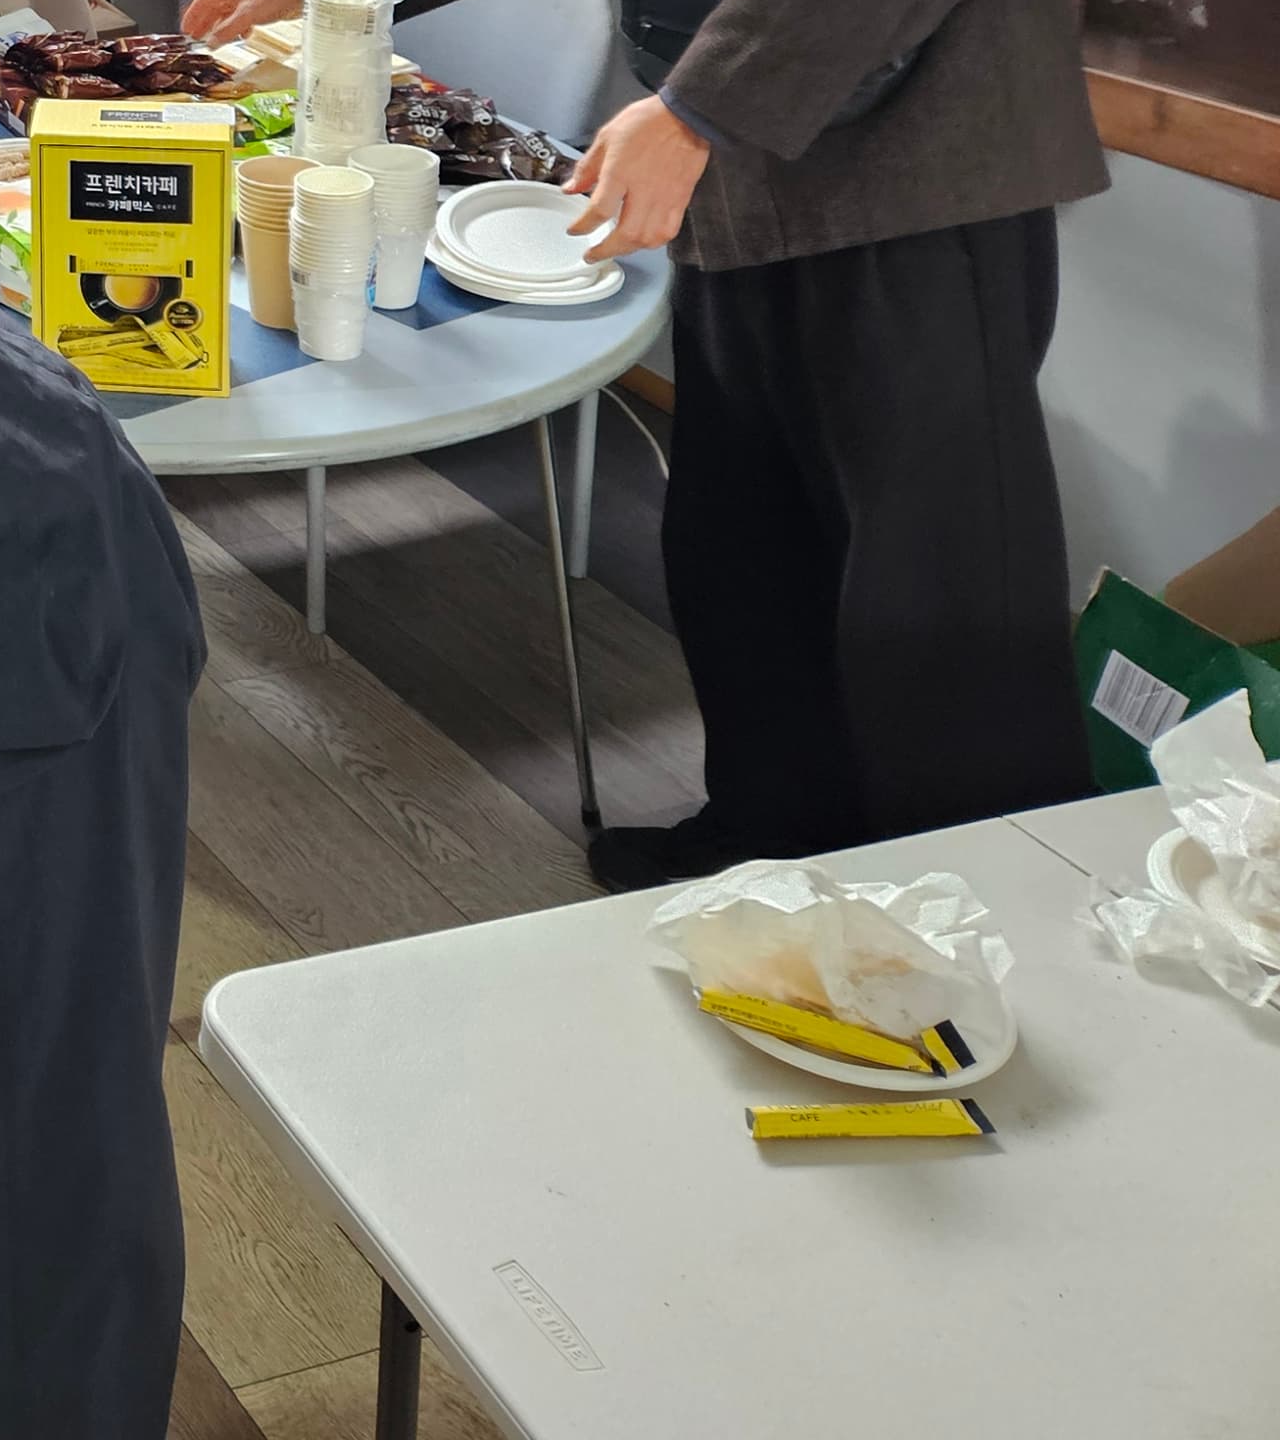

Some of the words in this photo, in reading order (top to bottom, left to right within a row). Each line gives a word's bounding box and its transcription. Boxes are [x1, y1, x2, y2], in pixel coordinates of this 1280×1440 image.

[85, 173, 178, 197] 프렌치카페
[107, 199, 155, 212] 카페믹스
[790, 1113, 821, 1123] CAFE
[510, 1277, 589, 1361] LIFETIME
